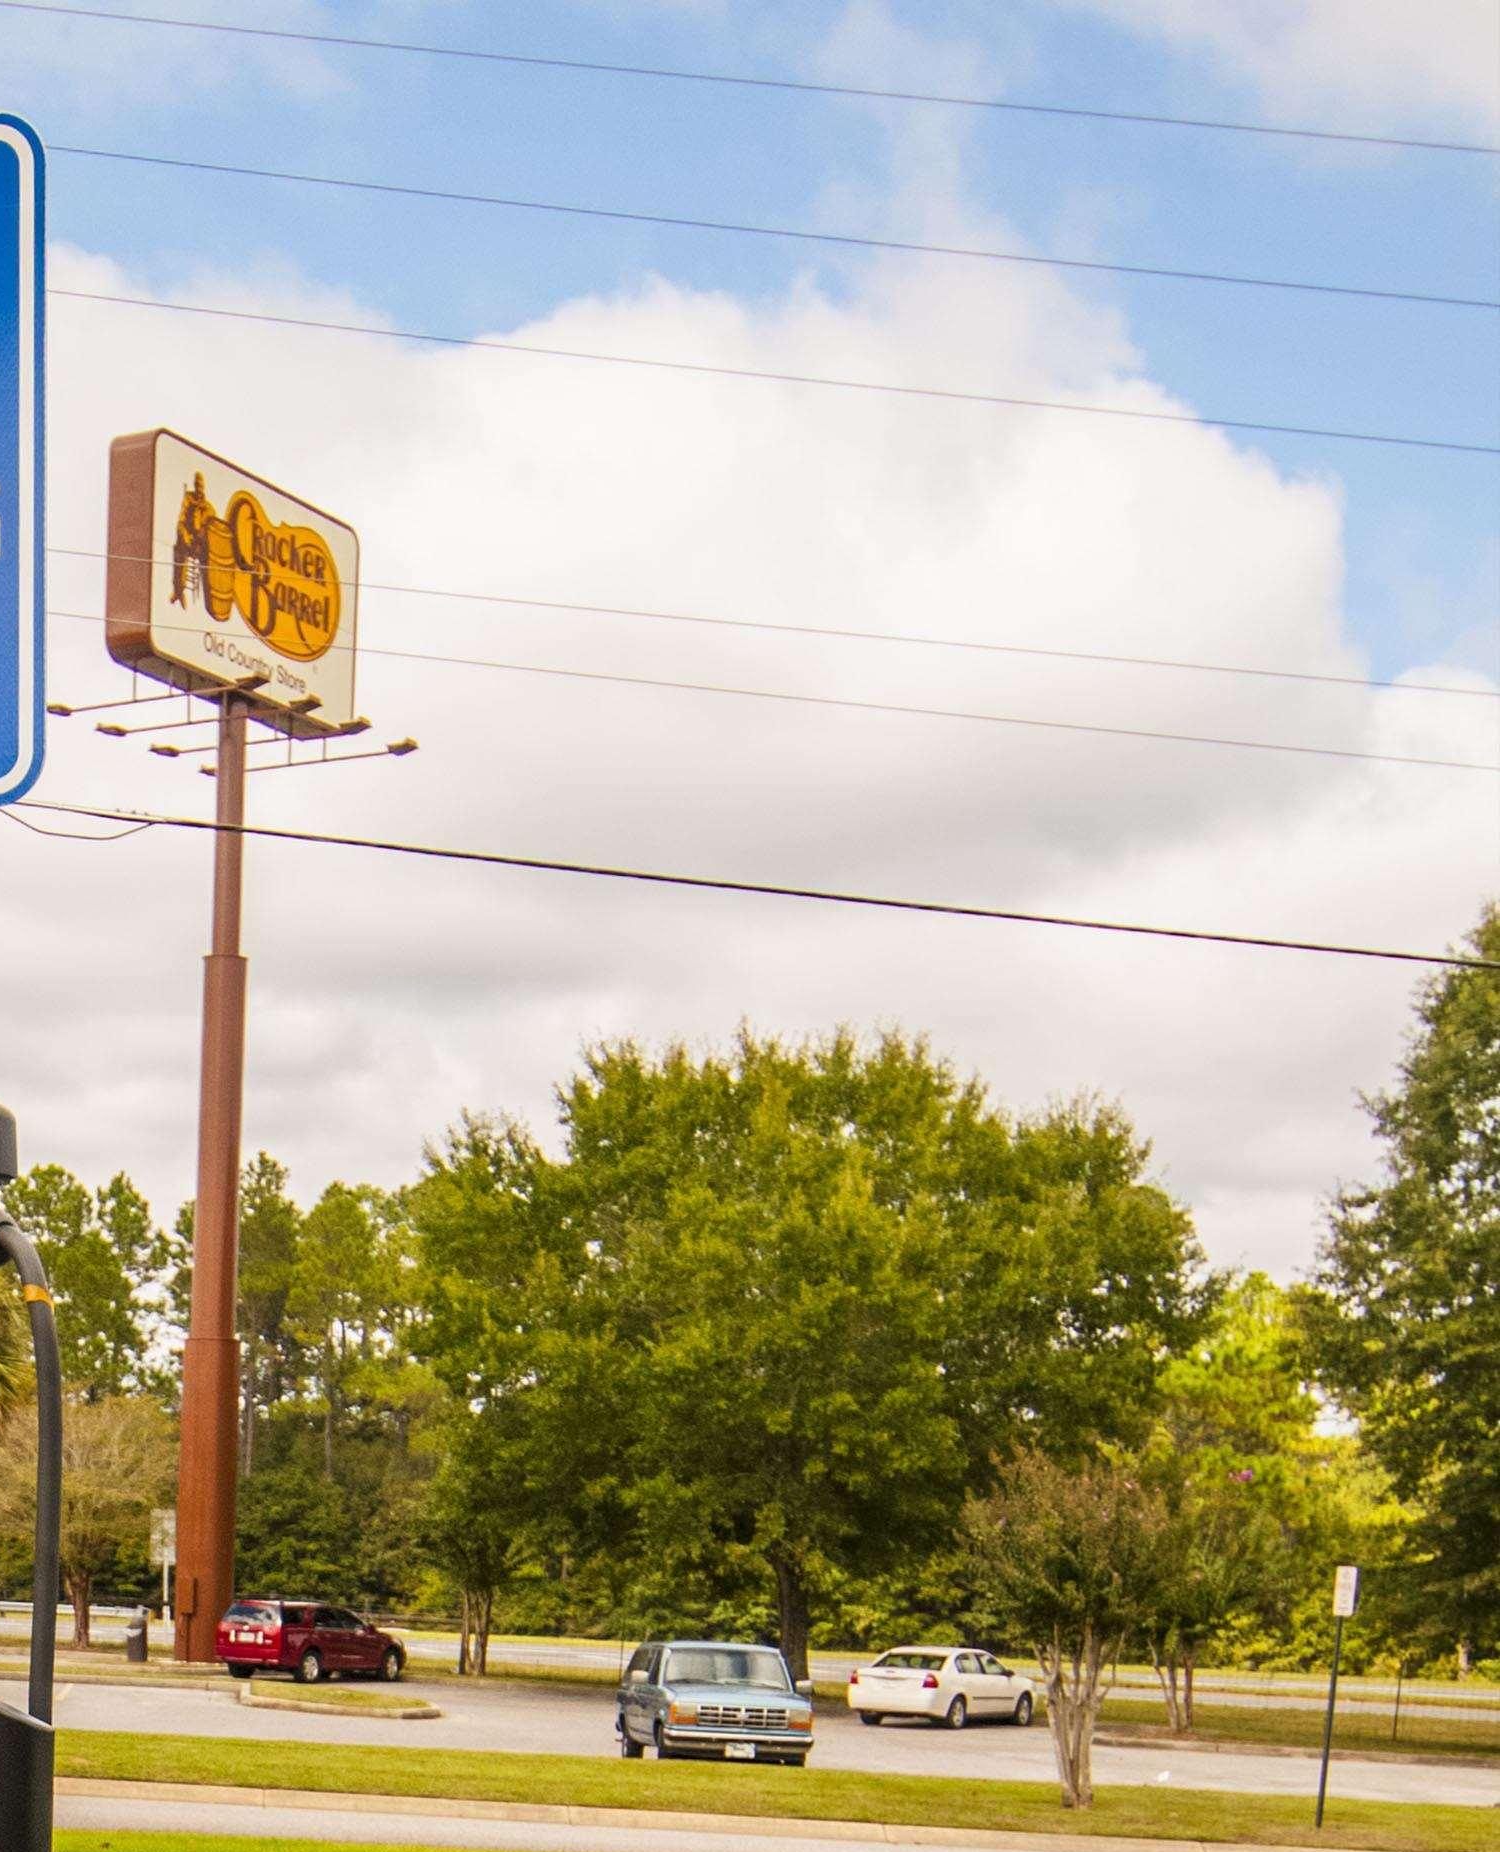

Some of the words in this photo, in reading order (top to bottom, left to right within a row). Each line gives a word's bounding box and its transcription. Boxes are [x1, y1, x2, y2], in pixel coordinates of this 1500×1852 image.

[203, 632, 225, 658] Old
[227, 643, 272, 678] Country
[277, 664, 306, 694] Store
